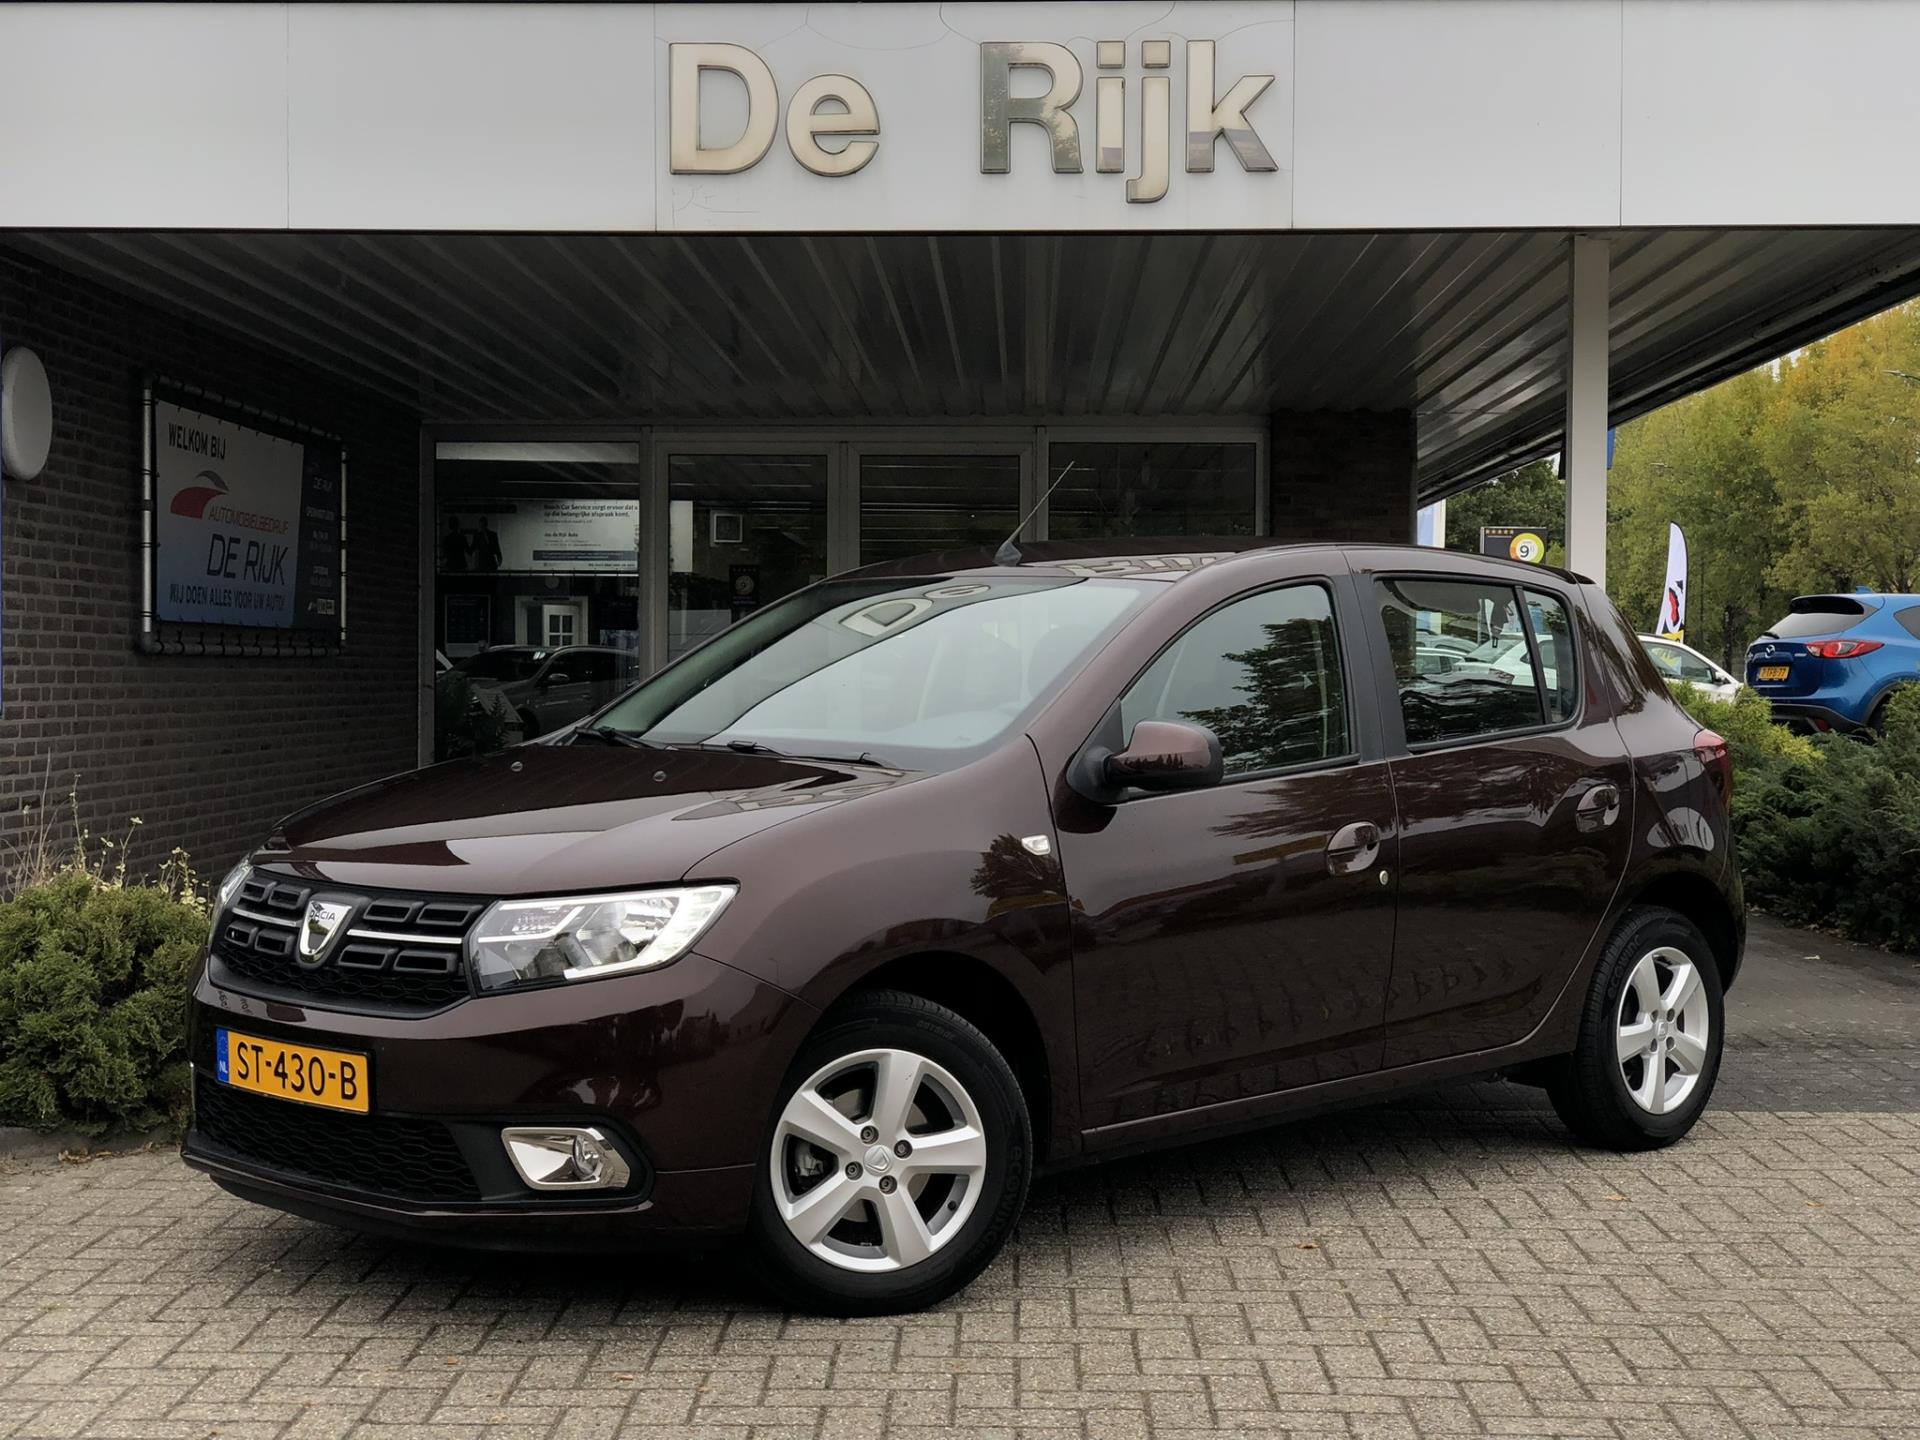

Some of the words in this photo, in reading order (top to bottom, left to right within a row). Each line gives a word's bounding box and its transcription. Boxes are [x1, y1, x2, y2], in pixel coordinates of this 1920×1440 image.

[669, 42, 881, 178] De
[980, 40, 1278, 203] Rijk
[168, 422, 208, 456] WELKOM
[210, 436, 226, 459] BIJ
[207, 533, 240, 578] DE
[243, 541, 288, 585] RIJK
[169, 583, 184, 604] WIJ
[186, 586, 207, 606] DOEN
[209, 588, 232, 607] ALLES
[234, 591, 252, 609] VOOR
[310, 910, 336, 921] DACIA
[219, 1061, 228, 1074] NL
[237, 1042, 357, 1100] ST-430-B
